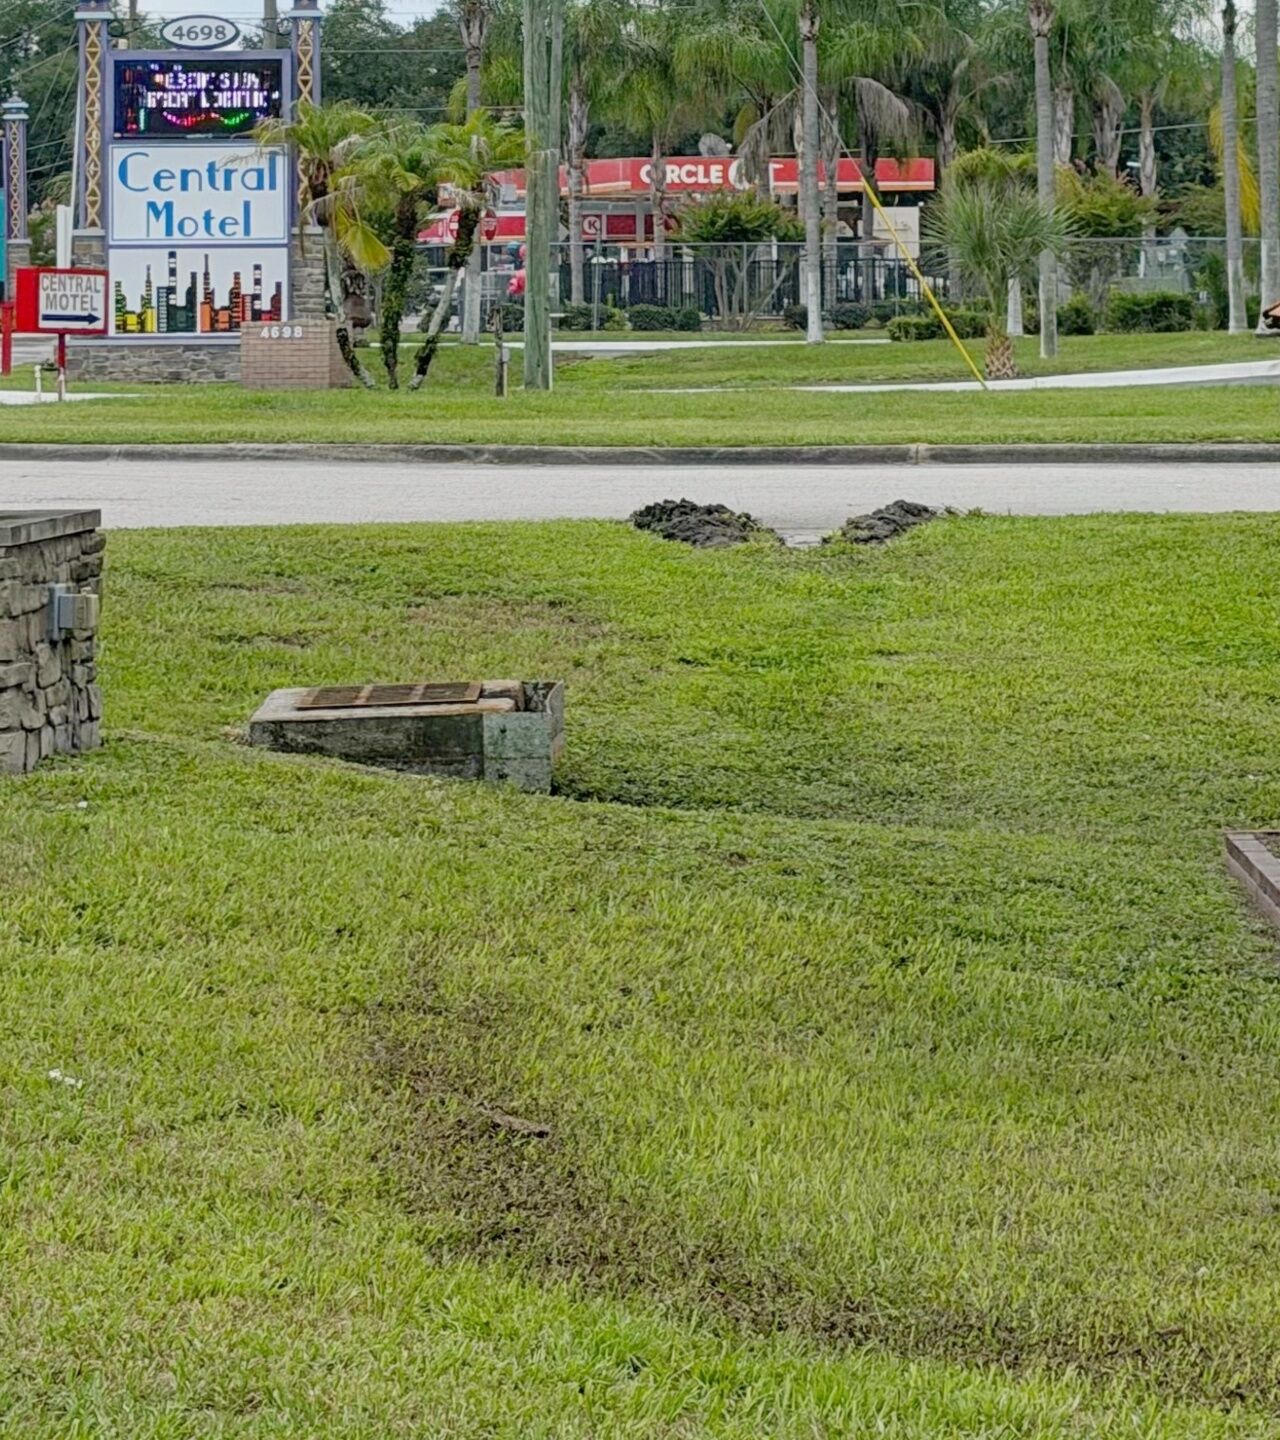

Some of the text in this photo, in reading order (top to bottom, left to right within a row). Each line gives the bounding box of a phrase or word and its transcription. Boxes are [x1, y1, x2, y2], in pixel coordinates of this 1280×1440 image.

[172, 25, 227, 41] 4698
[118, 150, 277, 192] Central
[640, 164, 724, 185] CRCLE
[146, 200, 252, 238] Motel
[41, 275, 101, 293] CENTRAL
[45, 294, 99, 311] MOTEL
[260, 326, 303, 338] 4698
